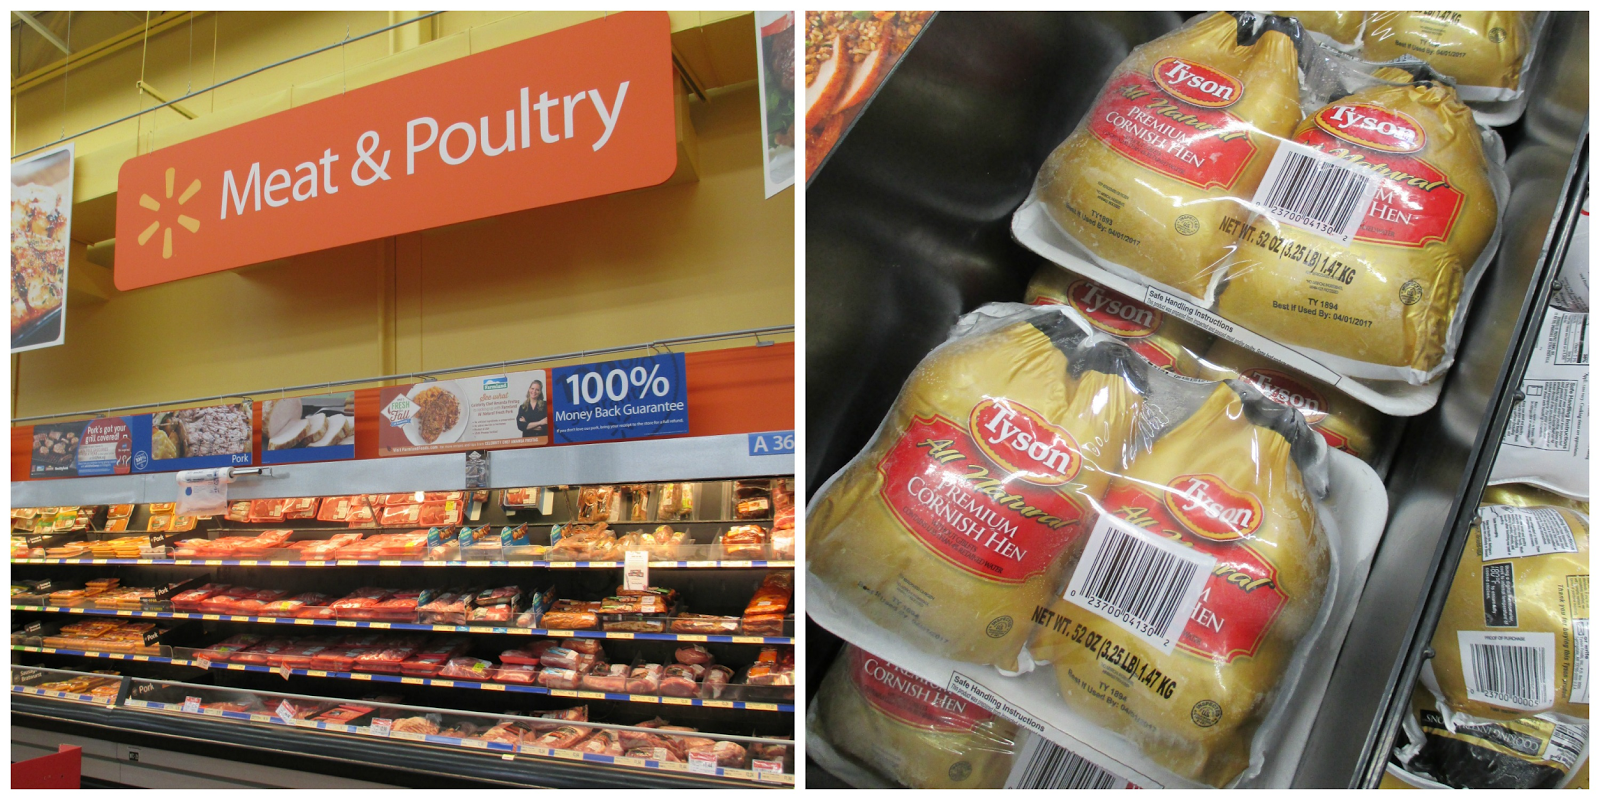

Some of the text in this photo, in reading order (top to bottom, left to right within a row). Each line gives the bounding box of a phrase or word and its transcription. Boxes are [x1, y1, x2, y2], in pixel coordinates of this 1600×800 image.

[1451, 13, 1462, 23] KG
[1412, 44, 1426, 52] Used
[1118, 84, 1150, 100] All
[1165, 60, 1233, 100] Tyson
[1127, 106, 1193, 148] PREMIUM
[1330, 105, 1416, 145] Tyson
[220, 80, 630, 219] Meat & Poultry
[1106, 111, 1164, 149] CORNISH
[1167, 140, 1206, 168] HEN
[1066, 202, 1140, 246] Best Used By: 04/01/2017
[1271, 207, 1300, 222] 23700
[1303, 218, 1334, 234] 04130
[1369, 202, 1414, 226] HEN
[1219, 216, 1240, 236] NET
[1240, 222, 1256, 242] WT.
[1256, 230, 1270, 248] 52
[1268, 236, 1285, 254] OZ
[1279, 242, 1306, 262] (3.25
[1303, 249, 1322, 273] LB)
[1320, 256, 1342, 279] 1.47
[1338, 265, 1356, 285] KG
[1080, 282, 1154, 328] Tyson
[1149, 290, 1234, 332] Safe Handling Instructions
[1272, 300, 1290, 310] Best
[1298, 305, 1316, 316] Used
[1318, 310, 1331, 320] By:
[1332, 313, 1372, 328] 04/01/2017
[1308, 298, 1338, 310] TY 1894
[1154, 301, 1166, 310] product
[1172, 308, 1188, 319] prepared
[1186, 314, 1194, 322] from
[1193, 318, 1208, 330] inspected
[1214, 328, 1226, 338] passed
[492, 392, 509, 400] what
[566, 364, 670, 405] 100%
[1252, 370, 1320, 412] Tyson
[390, 410, 410, 422] Fall
[391, 401, 410, 410] FRESH
[555, 401, 684, 422] Money Back Guarantee
[1566, 395, 1574, 418] Handling
[85, 432, 120, 444] grill covered!
[87, 425, 126, 434] Pork's got your
[984, 401, 1071, 475] Tyson
[1562, 418, 1571, 449] Instructions
[753, 434, 795, 453] A 36
[232, 454, 248, 464] Pork
[916, 438, 1081, 531] All Natural
[938, 480, 1018, 538] PREMIUM
[1182, 477, 1252, 528] Tyson
[907, 476, 1028, 562] CORNISH HEN
[1112, 505, 1159, 528] All
[153, 534, 164, 543] Pork
[955, 538, 977, 553] GIBLETS
[937, 533, 952, 546] THAN
[984, 562, 1004, 574] WATER
[158, 587, 168, 596] Pork
[1088, 596, 1120, 618] 23700
[1122, 614, 1156, 637] 04130
[1190, 602, 1225, 634] HEN
[1558, 604, 1566, 616] you
[1562, 616, 1570, 626] for
[147, 631, 158, 641] Pork
[1562, 628, 1570, 648] buying
[1032, 606, 1054, 628] NET
[1053, 612, 1072, 636] WT.
[1072, 624, 1088, 644] 52
[1085, 630, 1102, 652] OZ
[1096, 638, 1125, 668] (3.25
[1123, 652, 1140, 680] LB)
[1138, 662, 1162, 688] 1.47
[1156, 676, 1176, 699] KG
[1562, 662, 1570, 678] Tyson
[138, 683, 155, 694] Pork
[864, 658, 931, 703] CORNISH
[931, 692, 967, 714] HEN
[950, 683, 978, 702] This product was
[1068, 668, 1118, 708] Best If Used By:
[1100, 681, 1128, 702] TY 1894
[954, 676, 970, 688] Safe
[970, 684, 1002, 710] Handling
[1002, 703, 1045, 732] Instructions
[1484, 690, 1509, 702] 23700
[1512, 696, 1539, 708] 00005
[1493, 728, 1539, 751] COOKING
